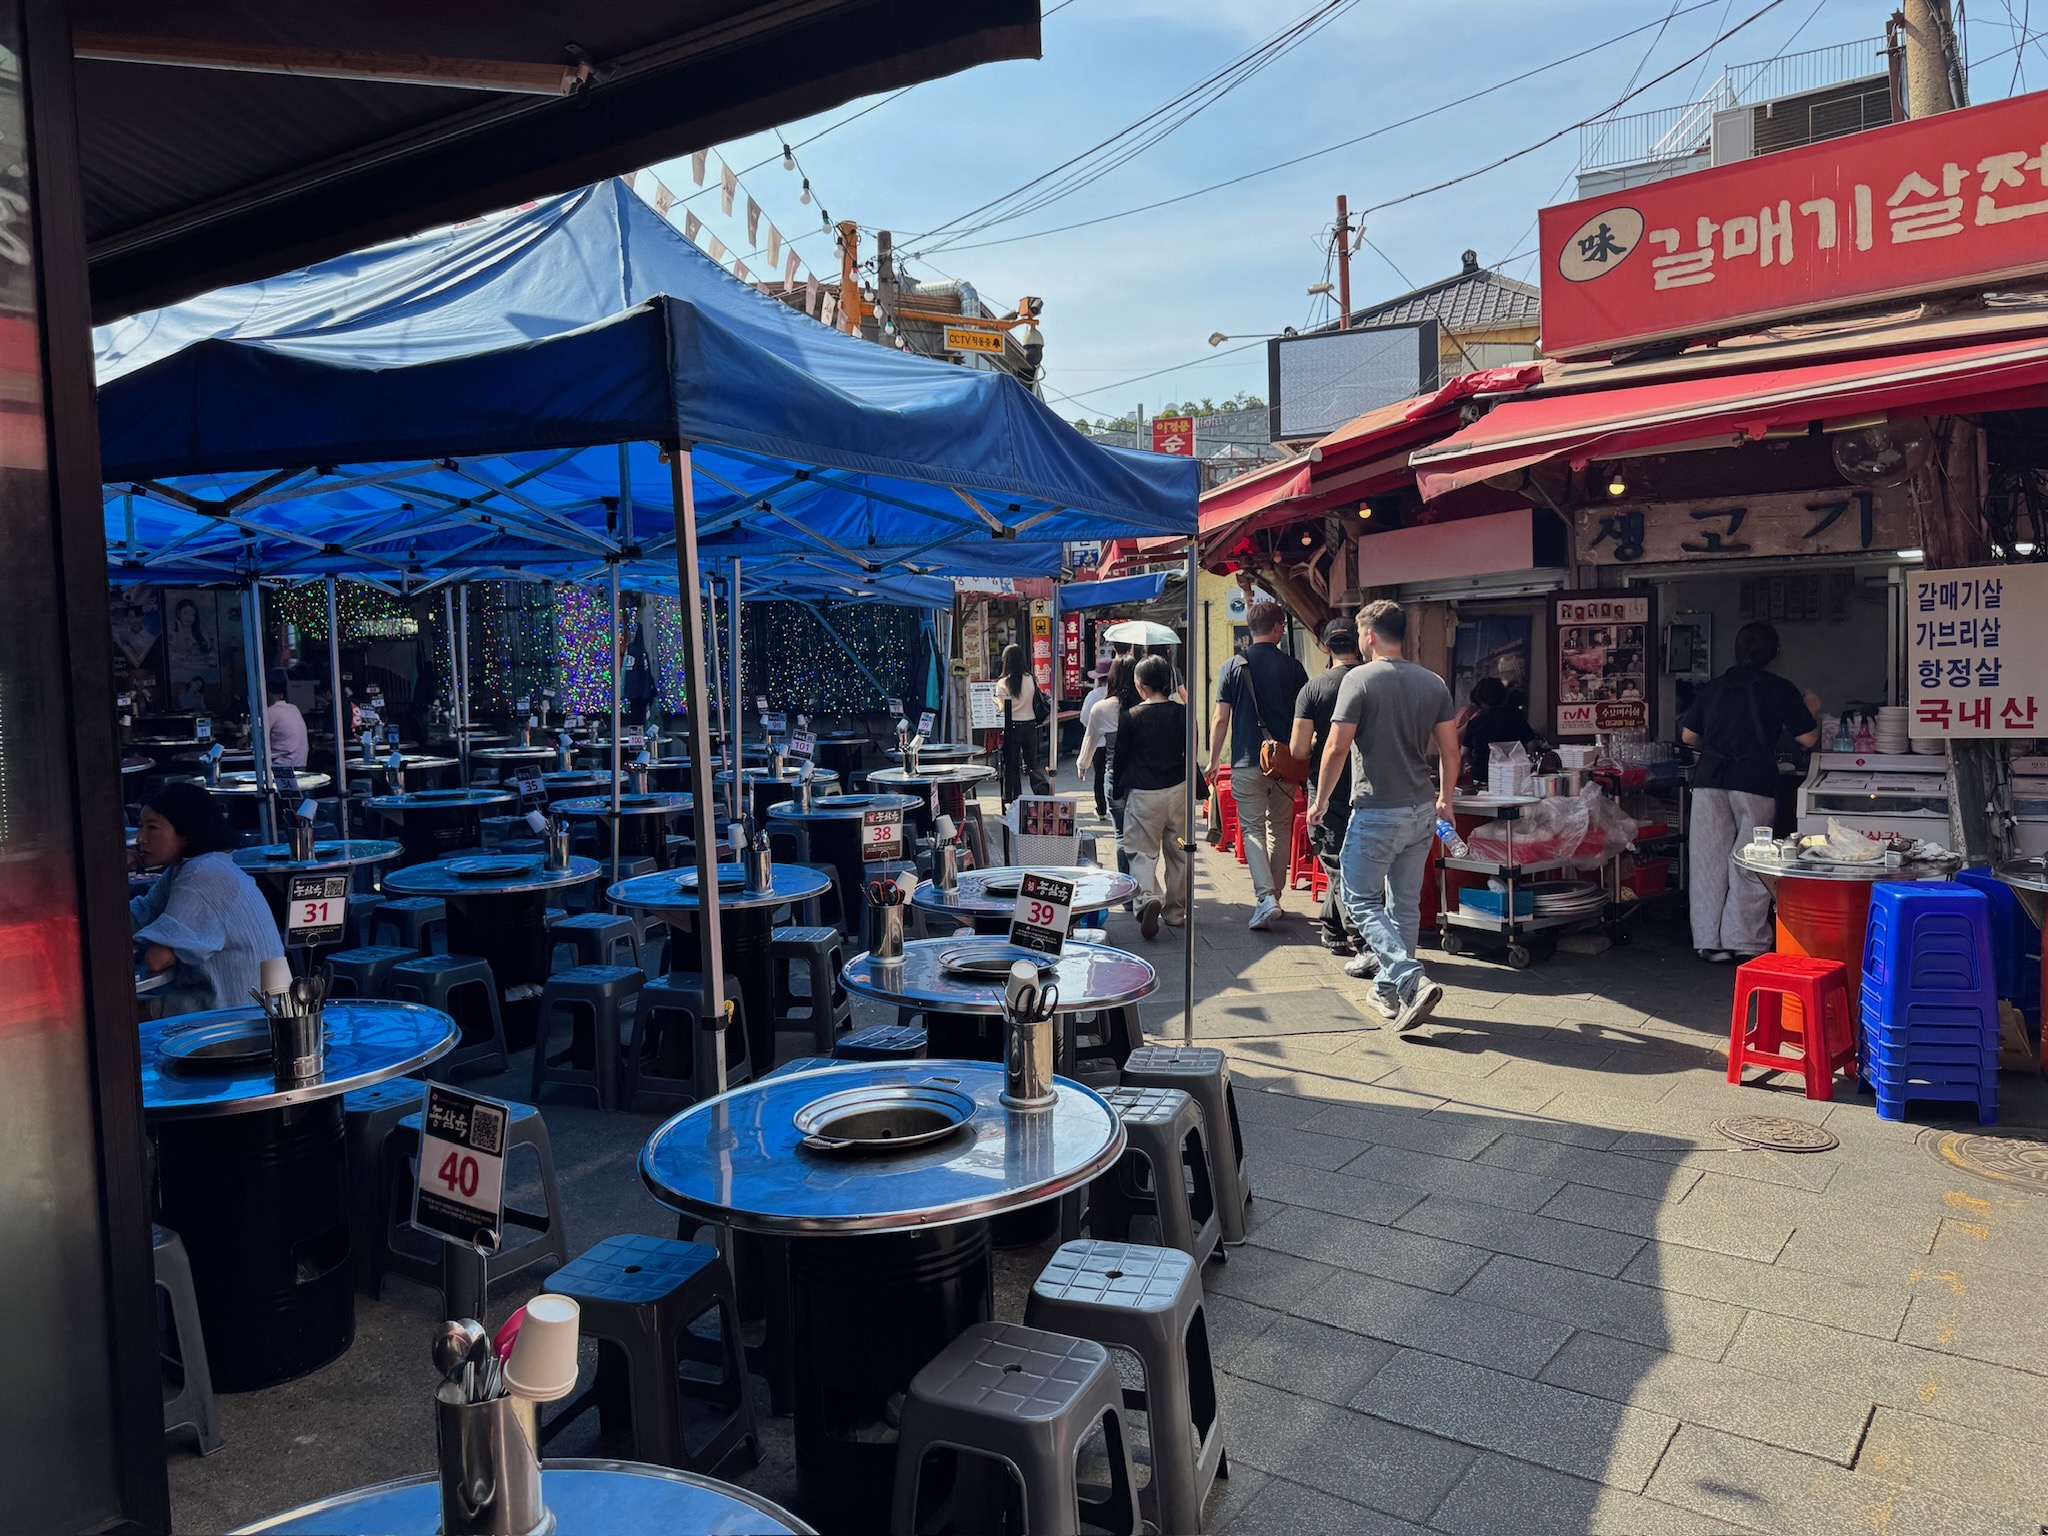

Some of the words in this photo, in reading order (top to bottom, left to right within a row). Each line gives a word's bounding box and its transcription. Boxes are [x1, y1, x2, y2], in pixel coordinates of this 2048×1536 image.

[1577, 223, 1627, 264] 味
[1917, 579, 2003, 612] 갈매기살
[1066, 621, 1078, 666] 호남선
[1916, 617, 2001, 650] 가브리살
[1033, 640, 1051, 700] 호남
[1918, 656, 2002, 689] 항정살
[1562, 707, 1590, 720] tvN
[1915, 695, 2039, 731] 국내산
[794, 741, 810, 751] 101
[525, 780, 538, 792] 35
[873, 826, 891, 841] 38
[303, 902, 329, 923] 31
[1027, 901, 1055, 926] 39
[438, 1151, 479, 1198] 40
